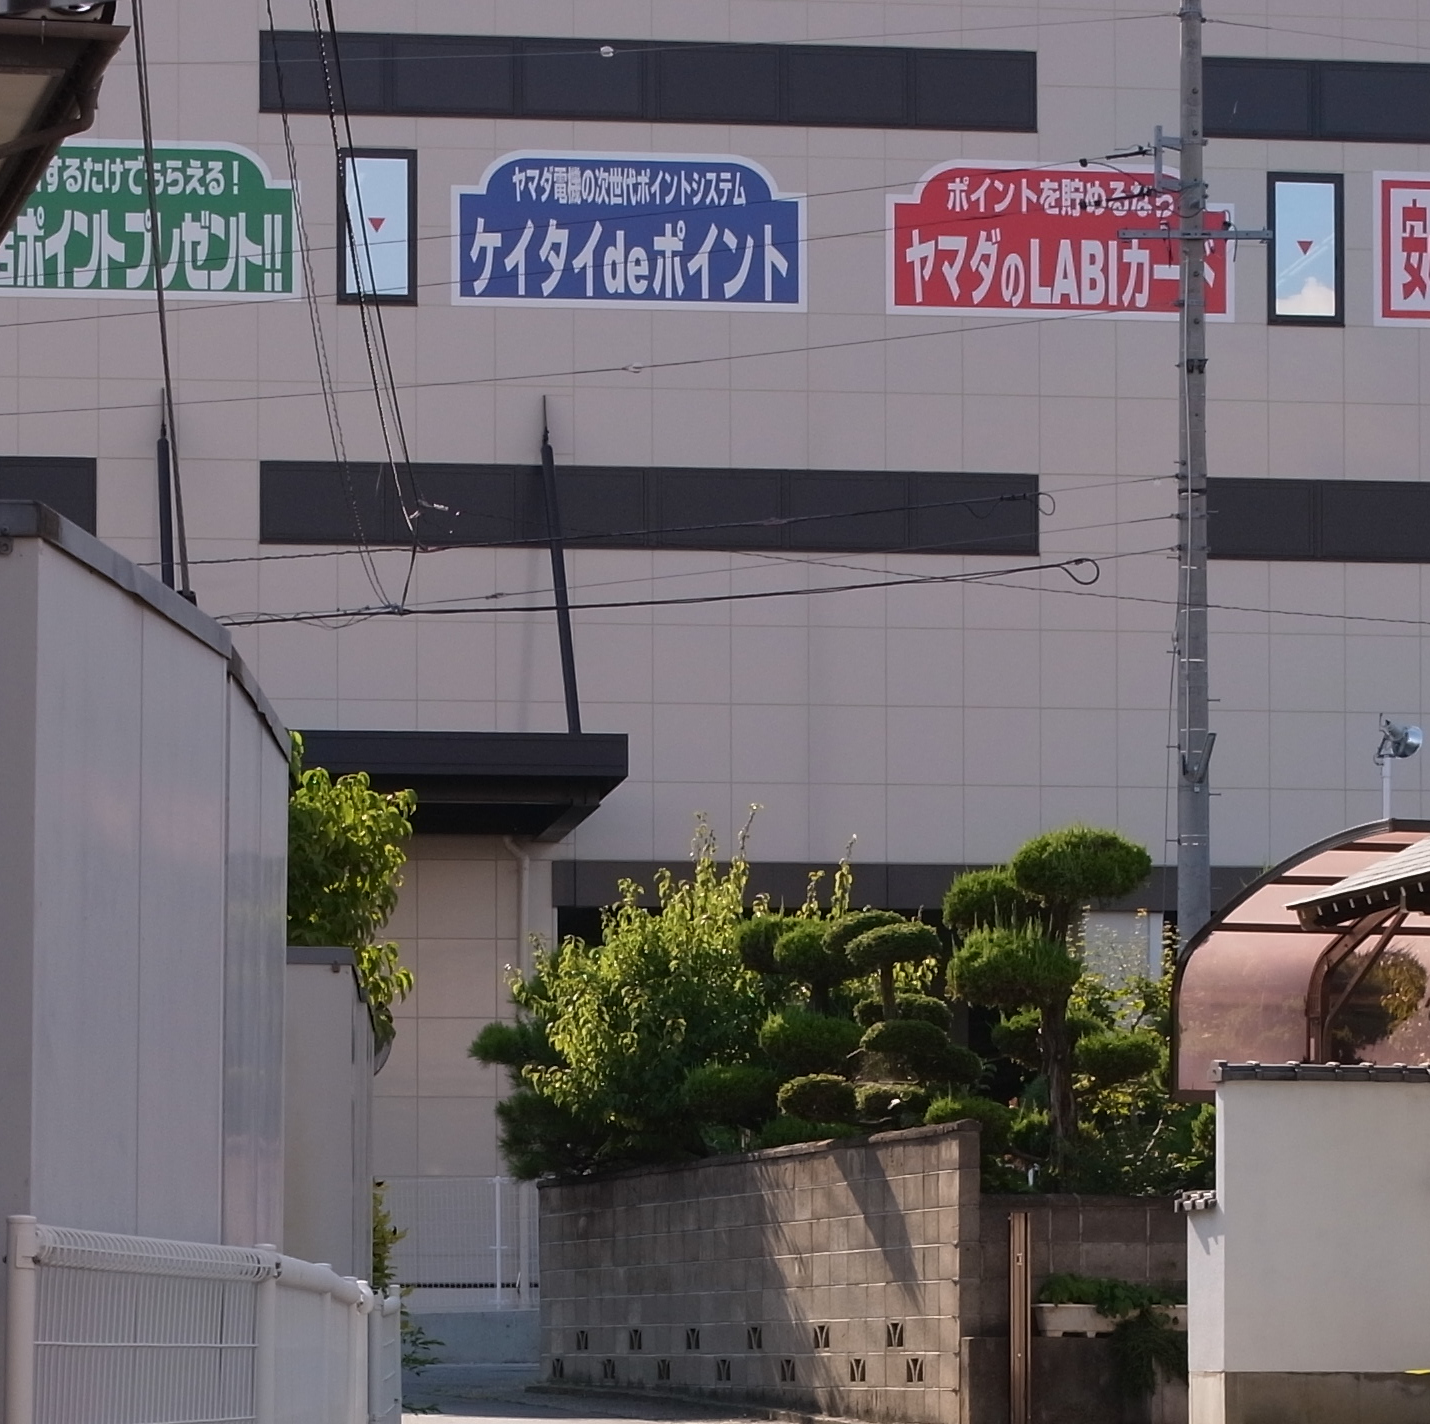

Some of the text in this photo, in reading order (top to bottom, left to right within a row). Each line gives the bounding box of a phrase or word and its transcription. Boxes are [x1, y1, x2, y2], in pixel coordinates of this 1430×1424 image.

[512, 165, 746, 207] ヤマダ電機の次世代ポイントシステム
[469, 217, 789, 302] ケイタイdeポイント
